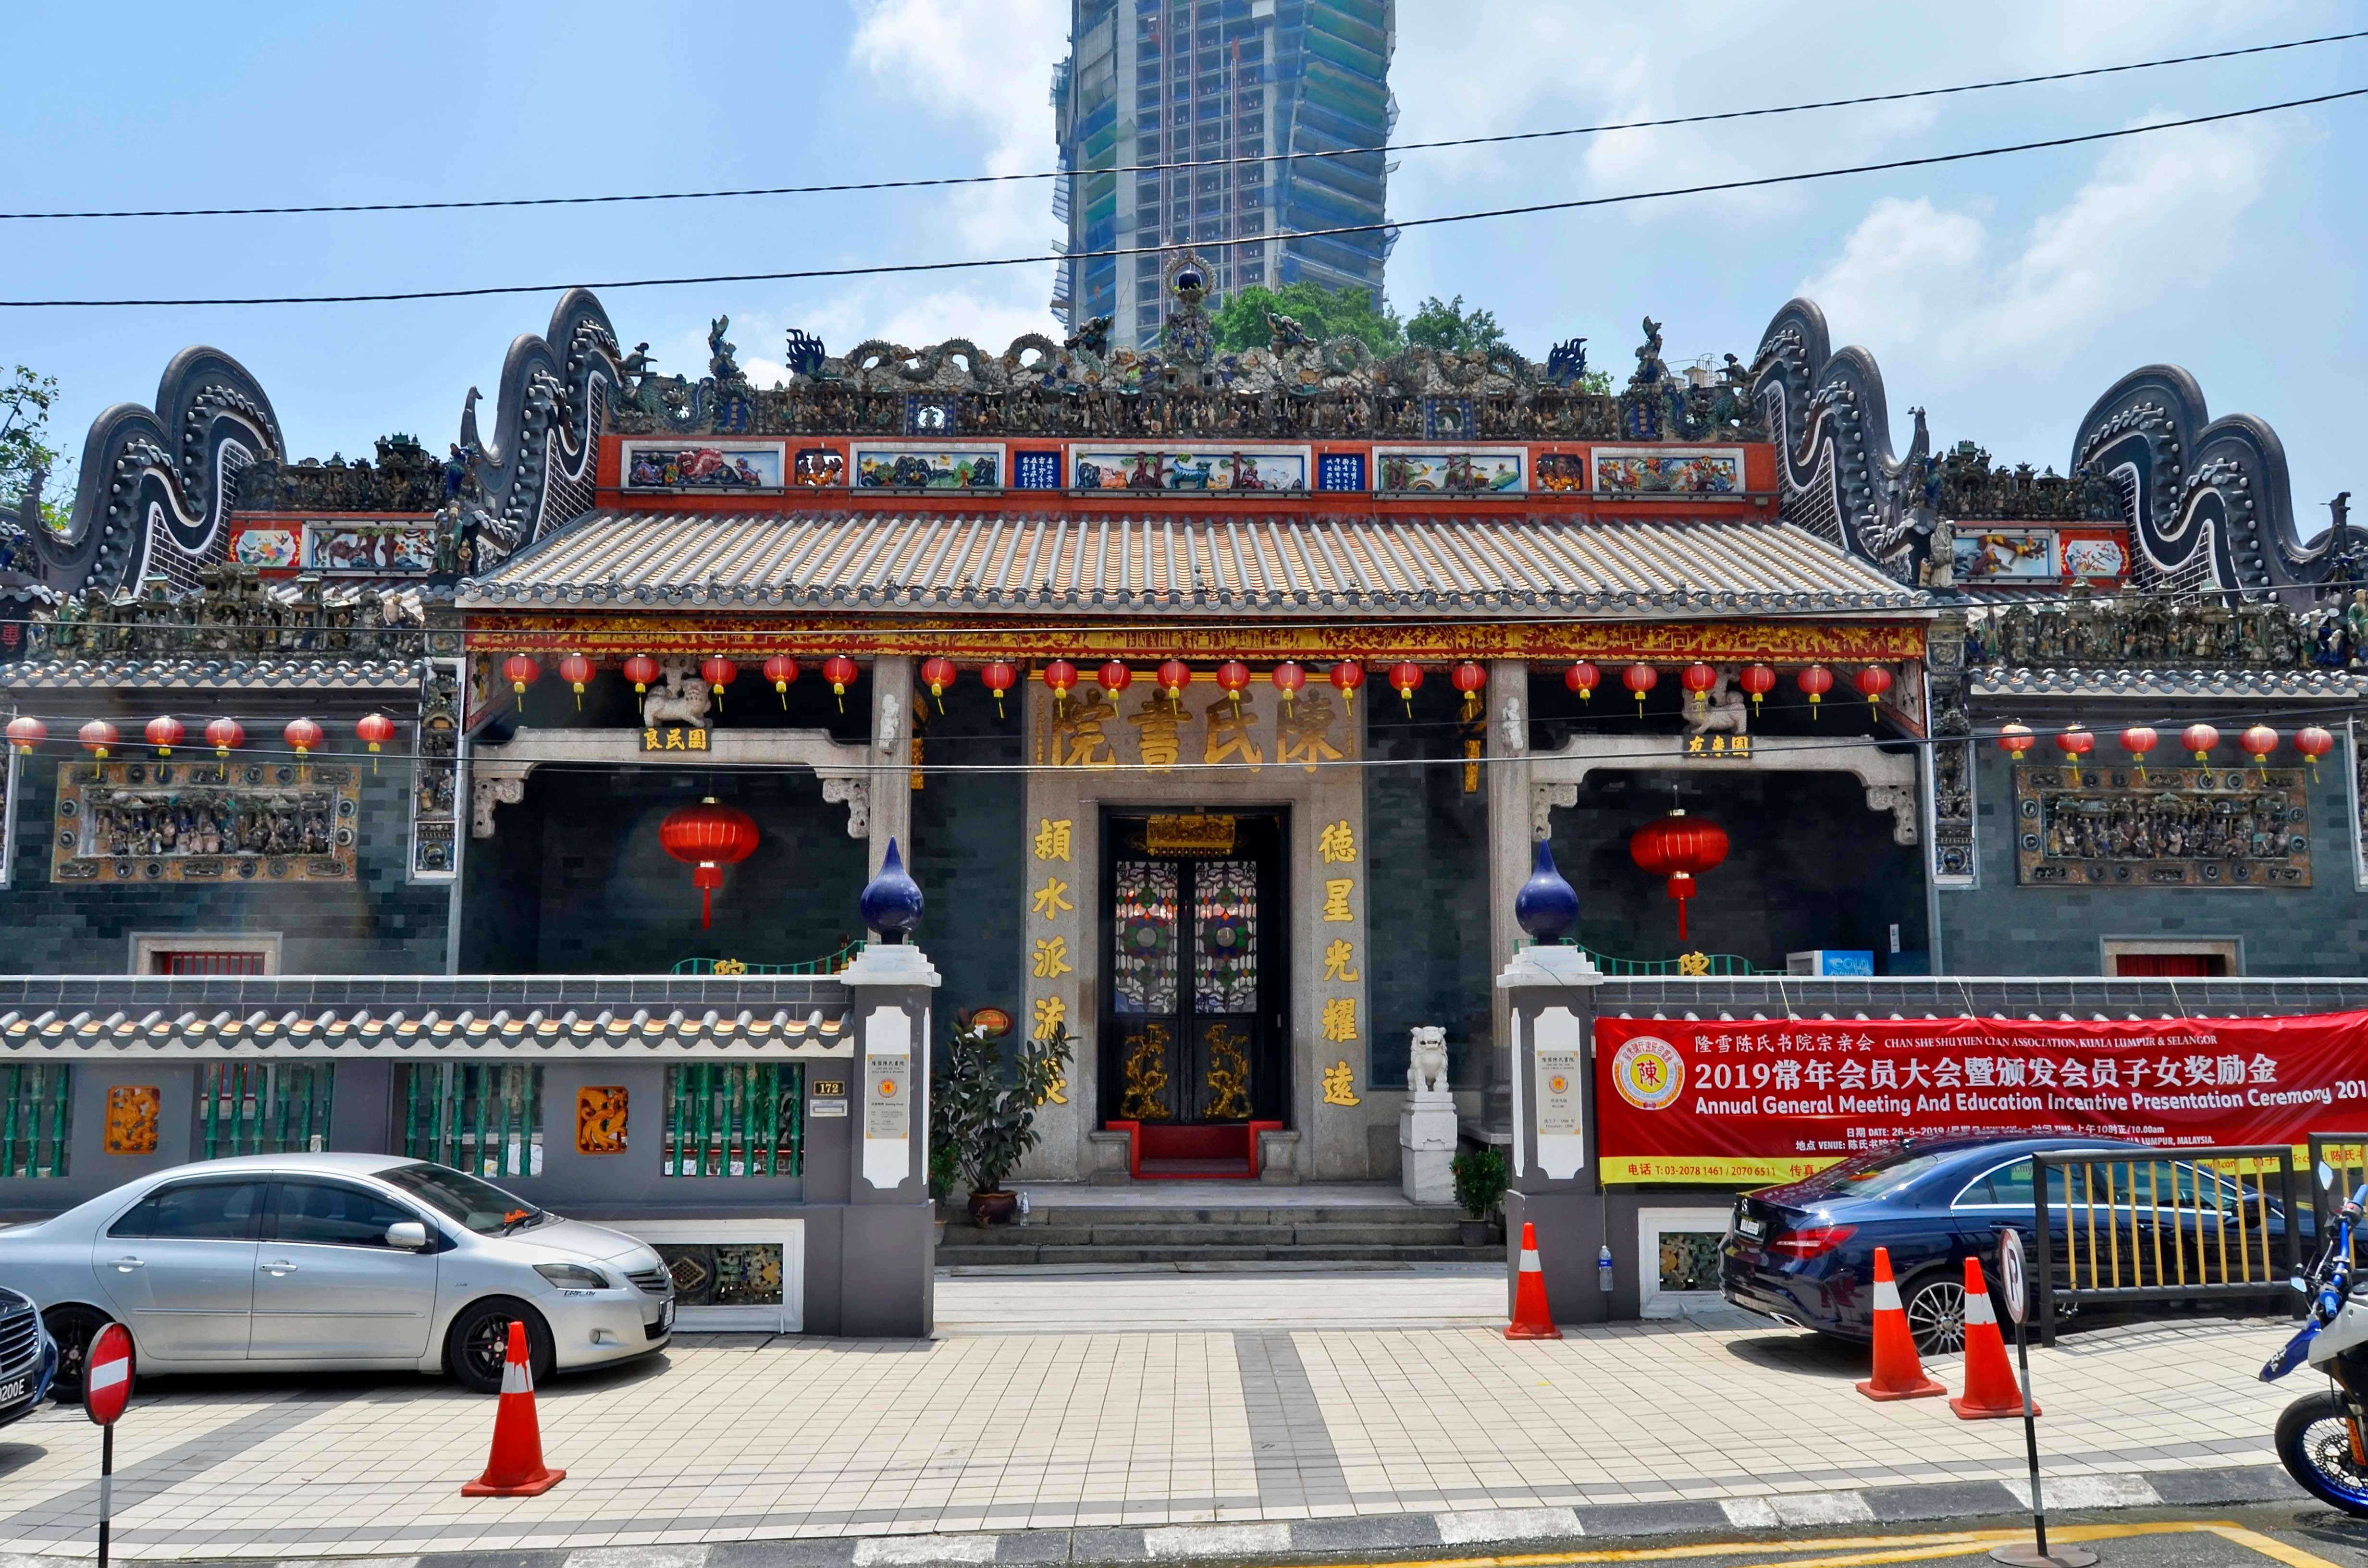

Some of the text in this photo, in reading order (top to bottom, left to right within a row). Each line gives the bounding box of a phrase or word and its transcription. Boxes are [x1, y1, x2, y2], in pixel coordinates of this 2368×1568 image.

[1051, 688, 1345, 773] 陳氏書院
[1832, 958, 1869, 970] COLD
[1695, 1033, 1875, 1053] 隆雪陈氏书院宗亲会
[1885, 1038, 1912, 1048] CHAN
[1915, 1038, 1933, 1047] SHE
[1936, 1038, 1955, 1047] SHU
[1957, 1037, 1983, 1046] YUEN
[2012, 1038, 2079, 1049] ASSOCIATION,
[2079, 1038, 2112, 1048] KUALA
[2114, 1037, 2155, 1048] LUMPUR
[2158, 1037, 2165, 1046] &
[2167, 1035, 2217, 1045] SELANGOR
[1637, 1060, 1661, 1087] 陳
[820, 1083, 839, 1093] 172
[1695, 1080, 2368, 1117] Annual General Meeting And Education Incentive Presentation Ceremony 201
[1847, 1127, 1865, 1138] 日期
[1868, 1128, 1889, 1137] DATE:
[1796, 1140, 1816, 1151] 地点
[1818, 1140, 1845, 1150] VENUE:
[2142, 1137, 2176, 1146] LUMPUR,
[2177, 1136, 2215, 1145] MALAYSIA.
[1628, 1164, 1652, 1176] 电话
[1655, 1167, 1663, 1175] T:
[1665, 1166, 1701, 1176] 03-2078
[1703, 1166, 1723, 1176] 1461
[1731, 1167, 1753, 1176] 2070
[1754, 1167, 1776, 1176] 6511
